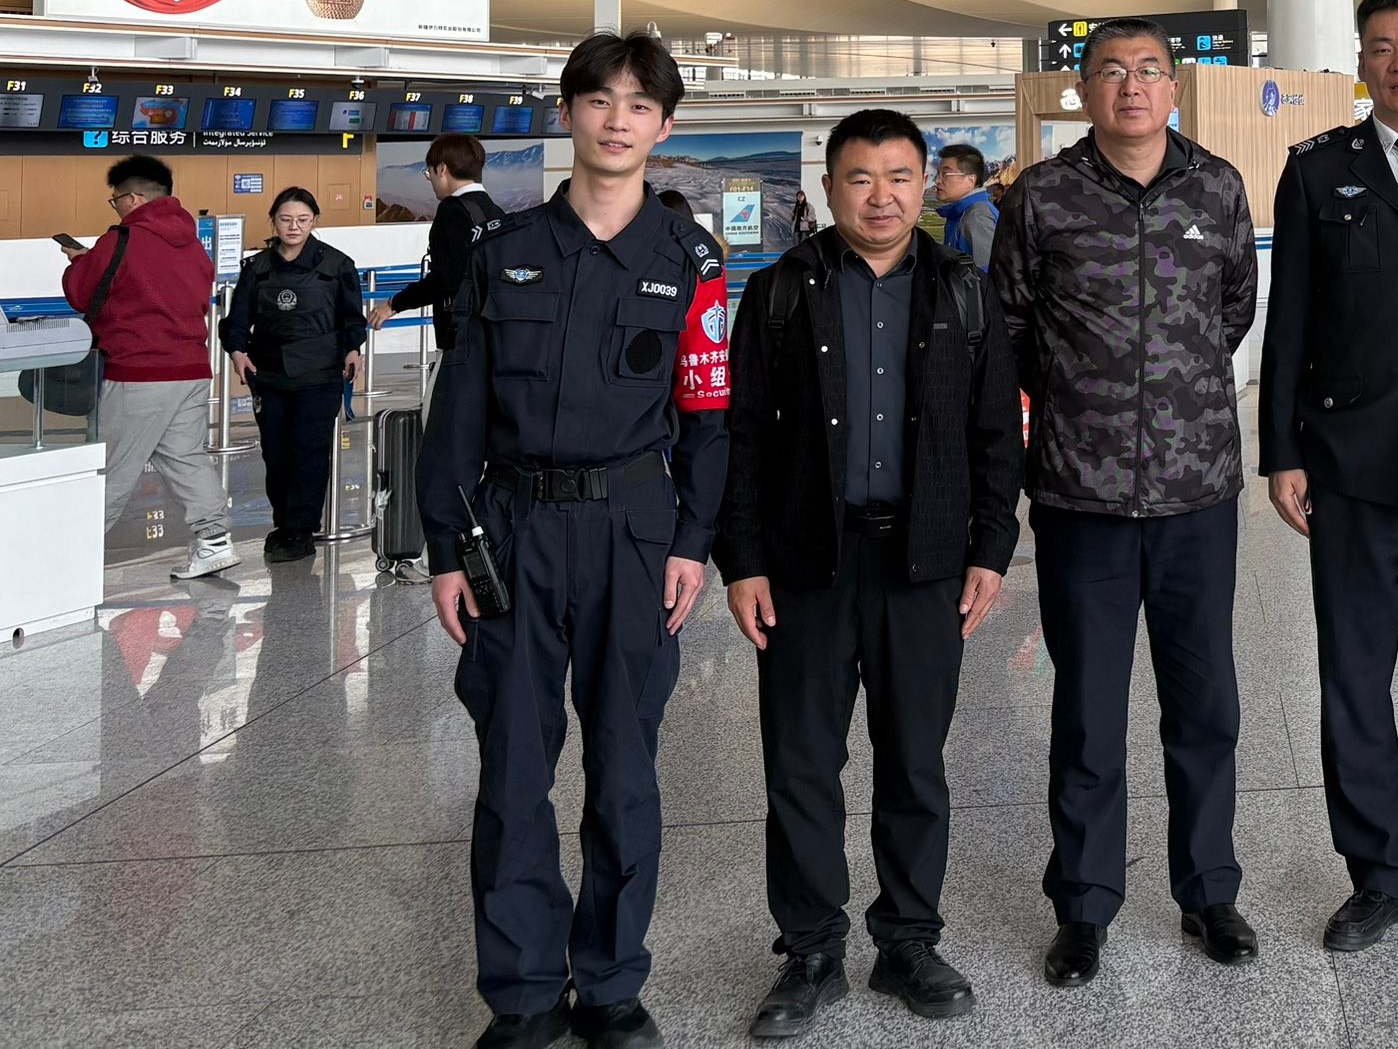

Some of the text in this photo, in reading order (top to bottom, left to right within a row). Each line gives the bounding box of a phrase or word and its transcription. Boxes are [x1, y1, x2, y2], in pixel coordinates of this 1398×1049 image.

[7, 80, 27, 91] F31
[82, 83, 102, 93] F32
[155, 85, 174, 95] F33
[223, 87, 241, 97] F34
[288, 89, 305, 99] F35
[349, 91, 365, 100] F36
[406, 93, 421, 102] F37
[459, 94, 474, 104] F38
[509, 96, 523, 105] F39
[641, 282, 677, 297] XJ0039
